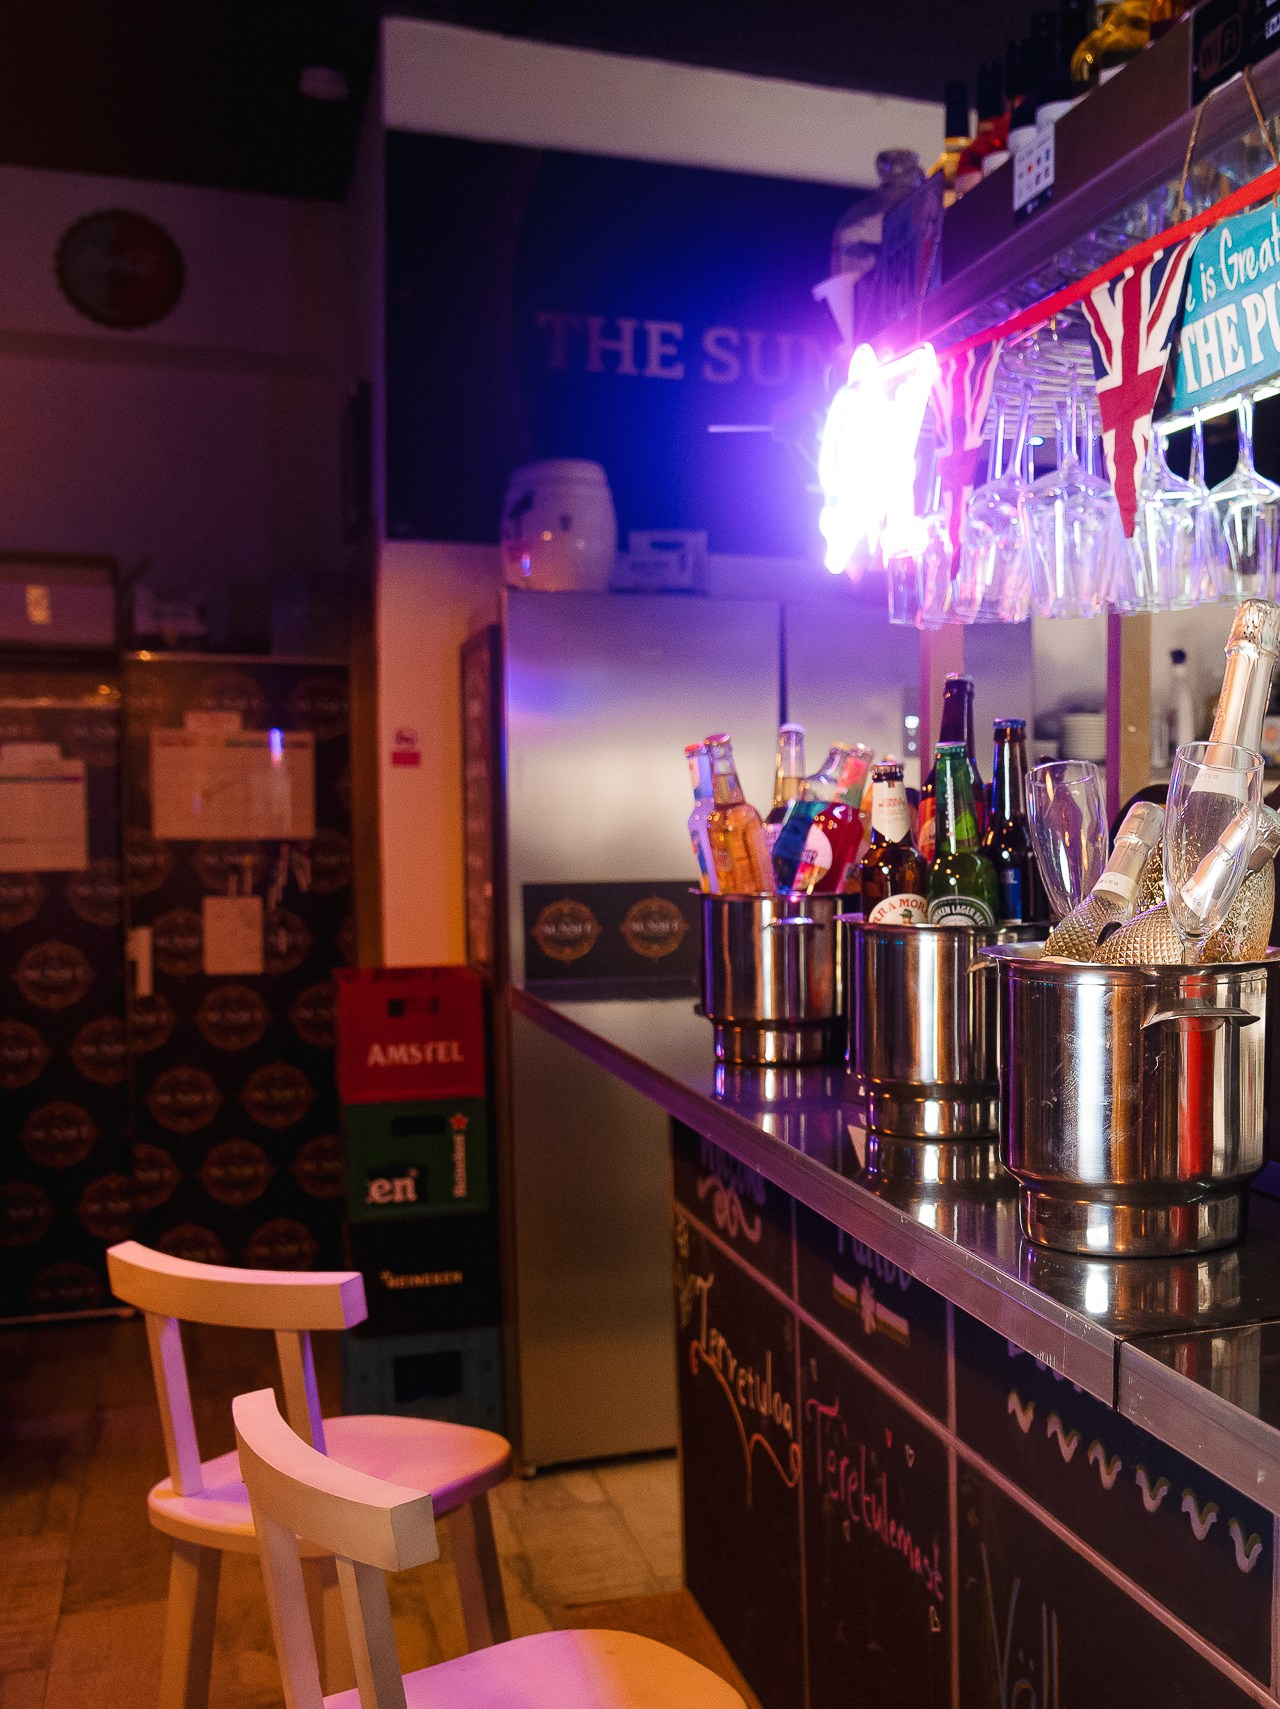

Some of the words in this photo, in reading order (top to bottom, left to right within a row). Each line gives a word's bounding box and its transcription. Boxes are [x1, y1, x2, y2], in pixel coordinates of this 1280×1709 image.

[1200, 262, 1217, 304] is
[1219, 211, 1280, 291] Great
[536, 310, 684, 381] THE
[1180, 303, 1246, 394] THE
[951, 904, 976, 917] LAGER
[367, 1040, 465, 1067] AMSTEL
[365, 1175, 418, 1205] en
